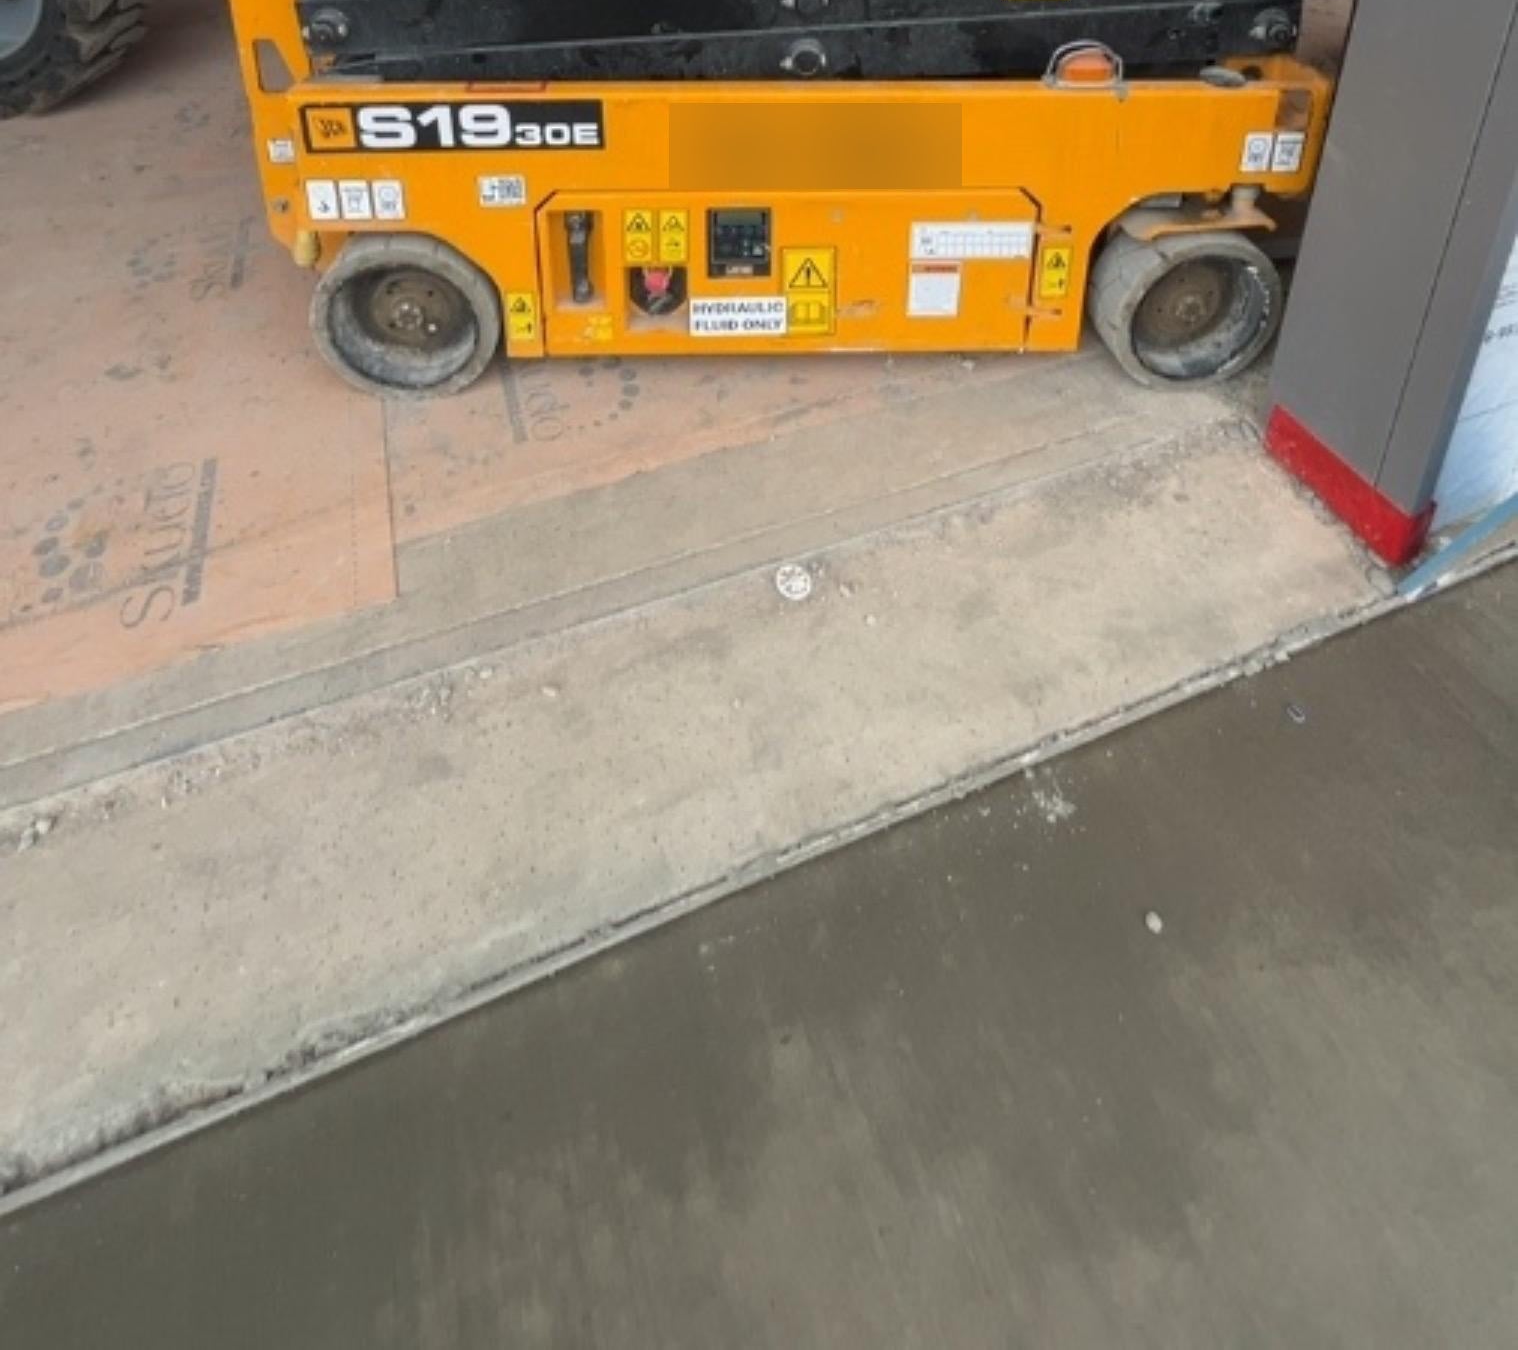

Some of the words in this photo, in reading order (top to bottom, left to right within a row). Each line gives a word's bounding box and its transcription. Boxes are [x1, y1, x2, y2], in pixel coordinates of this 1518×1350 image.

[692, 302, 784, 315] HYDRAULIC
[695, 319, 738, 332] FLUID
[743, 319, 782, 331] ONLY
